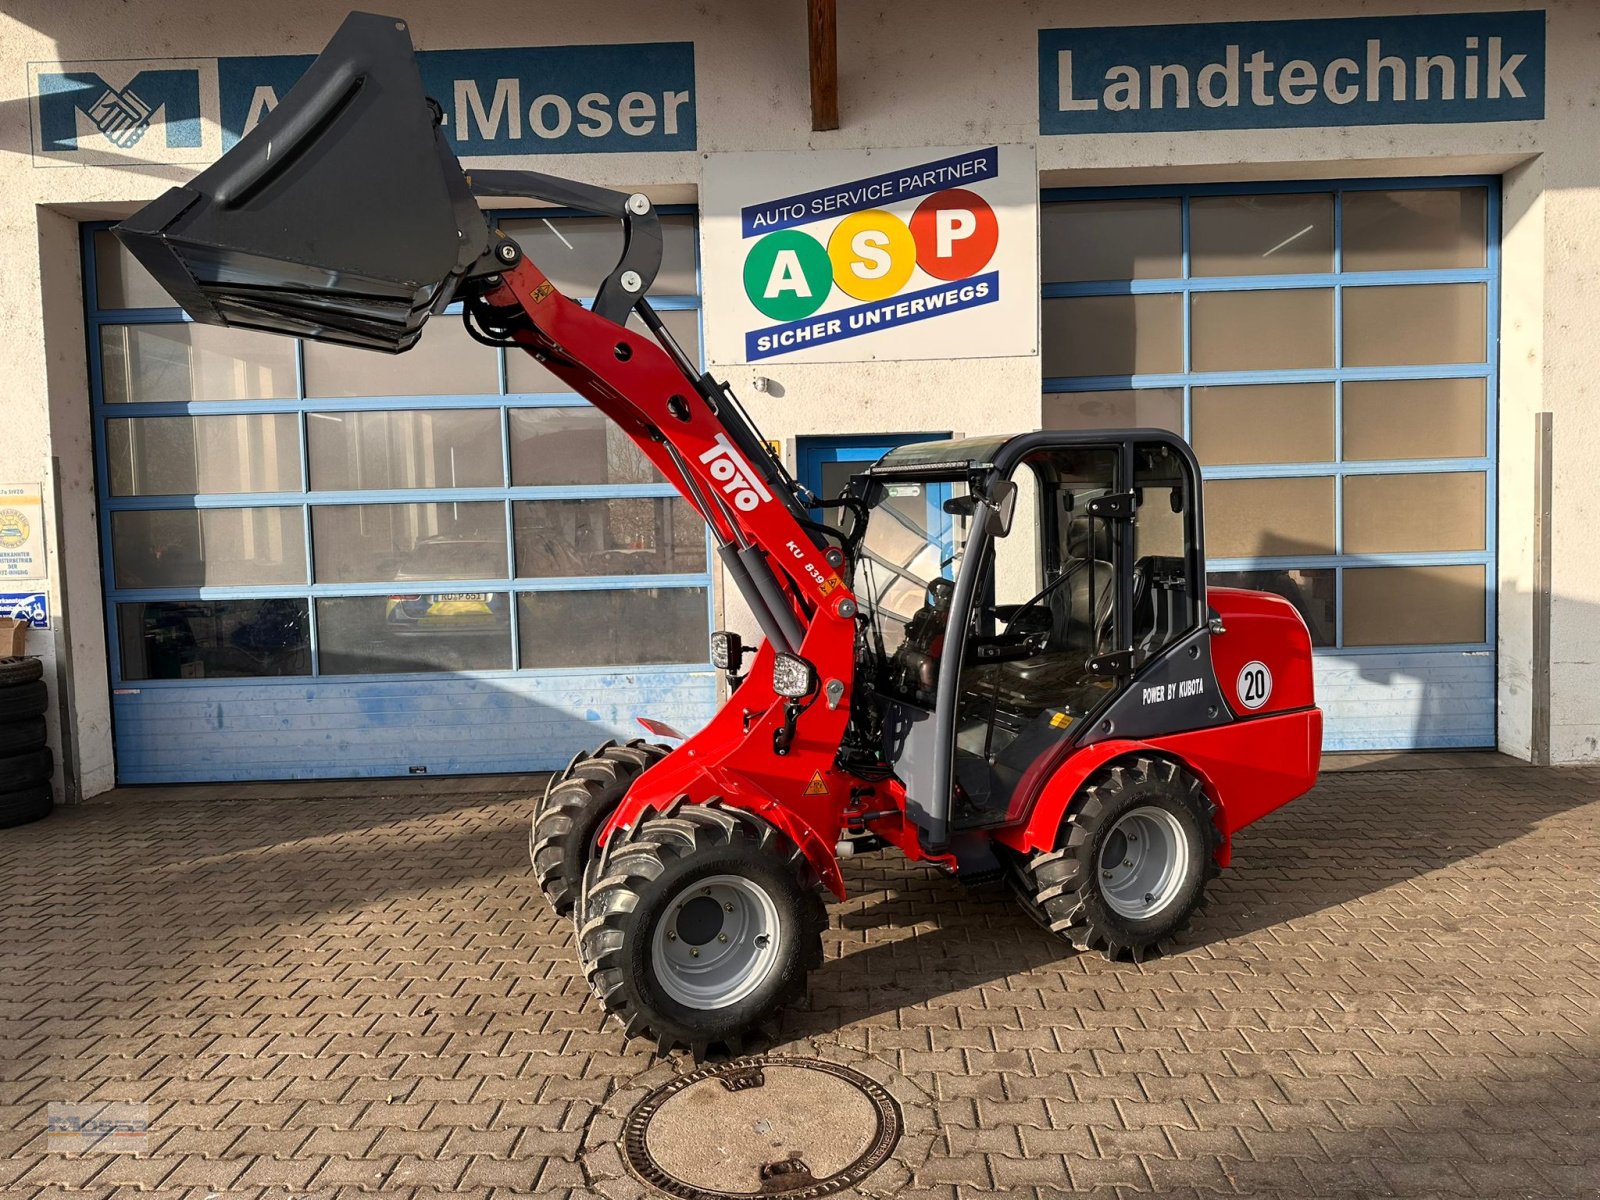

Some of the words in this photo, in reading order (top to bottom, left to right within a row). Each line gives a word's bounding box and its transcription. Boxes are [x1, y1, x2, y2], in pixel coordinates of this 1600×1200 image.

[1057, 36, 1527, 112] Landtechnik
[753, 203, 805, 228] AUTO
[811, 181, 894, 214] SERVICE
[899, 158, 987, 193] PARTNER
[757, 320, 842, 352] SICHER
[849, 282, 990, 329] UNTERWEGS
[698, 432, 774, 512] TOYO
[785, 540, 804, 559] KU
[804, 563, 825, 584] 839
[1142, 685, 1165, 705] POWER
[1167, 683, 1176, 701] BY
[1178, 677, 1204, 699] KUBOTA
[1244, 668, 1265, 701] 20
